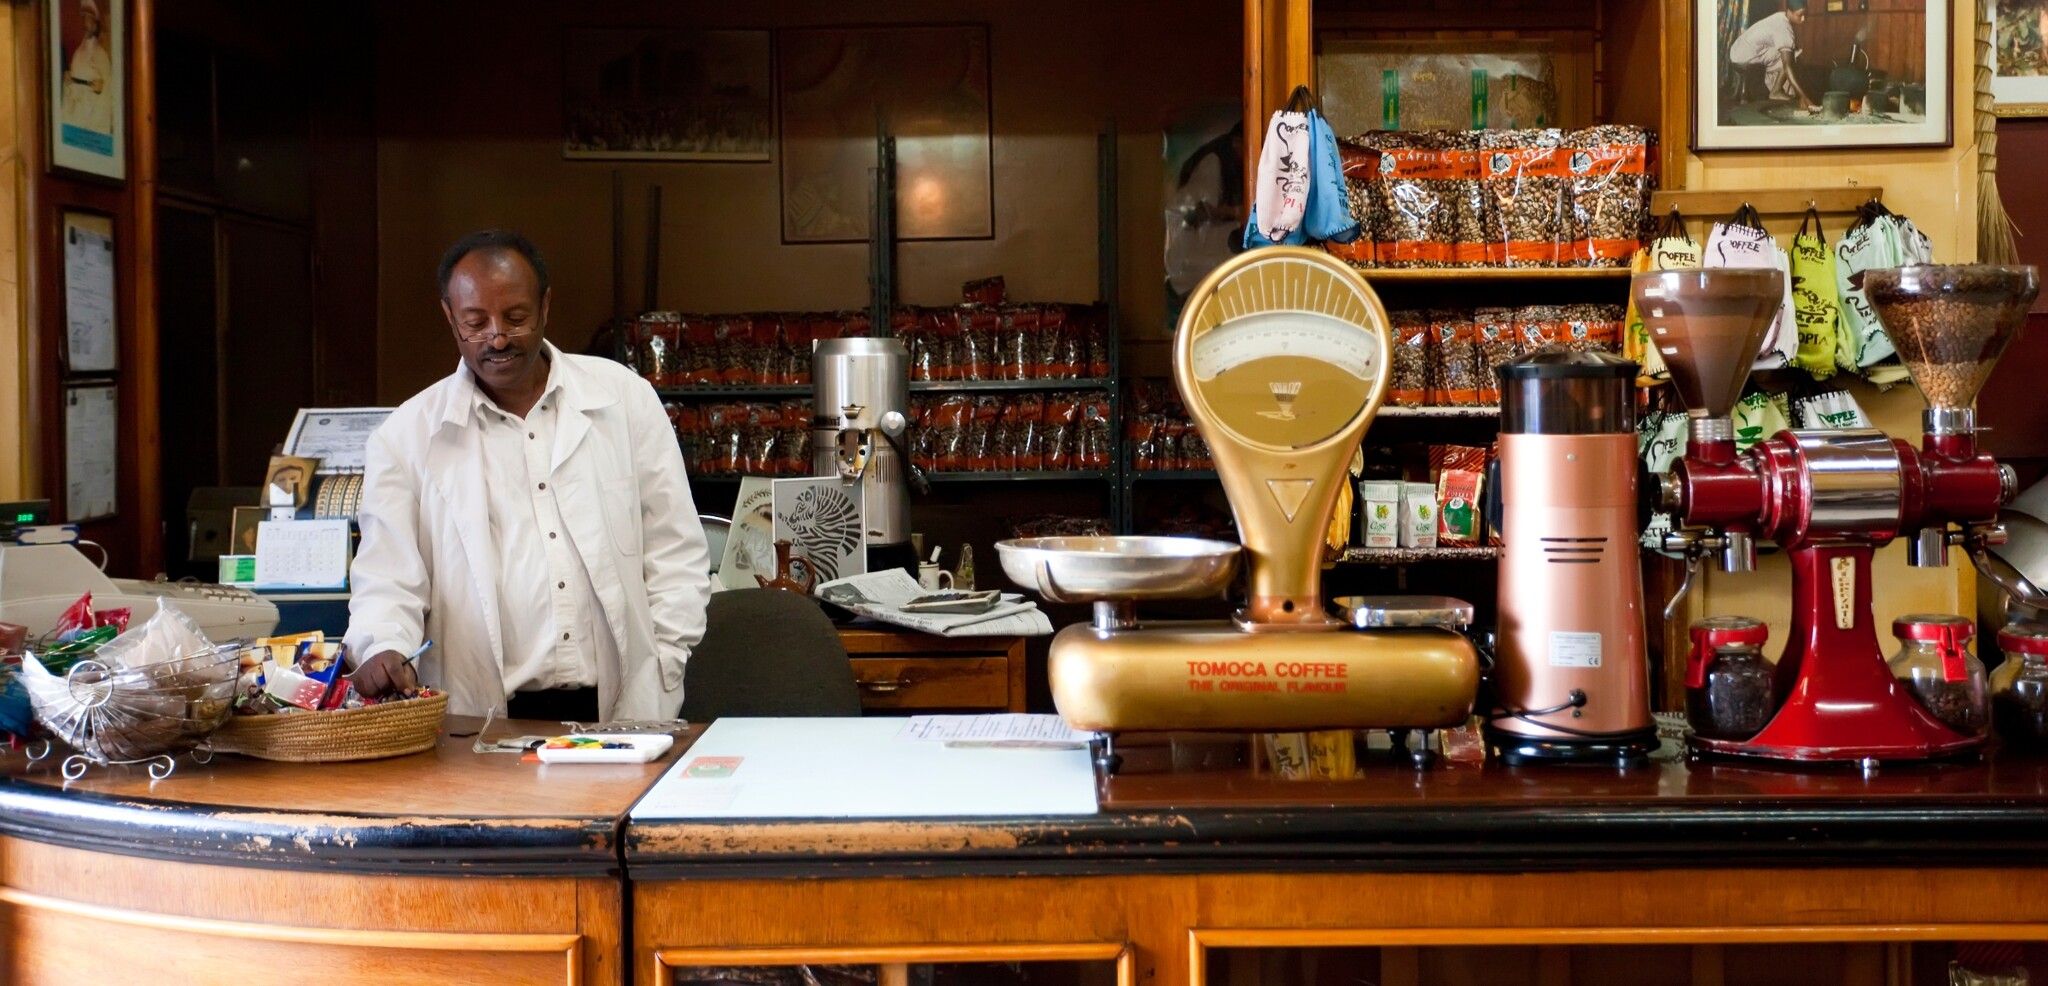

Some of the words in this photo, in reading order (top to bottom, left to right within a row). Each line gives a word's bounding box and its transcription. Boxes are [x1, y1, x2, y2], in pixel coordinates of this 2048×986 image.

[1658, 251, 1696, 264] COFFEE
[1186, 661, 1268, 677] TOMOCA
[1274, 662, 1348, 678] COFFEE
[1188, 679, 1214, 692] THE
[1219, 680, 1282, 693] ORIGINAL
[1286, 681, 1347, 694] FLAVOUR
